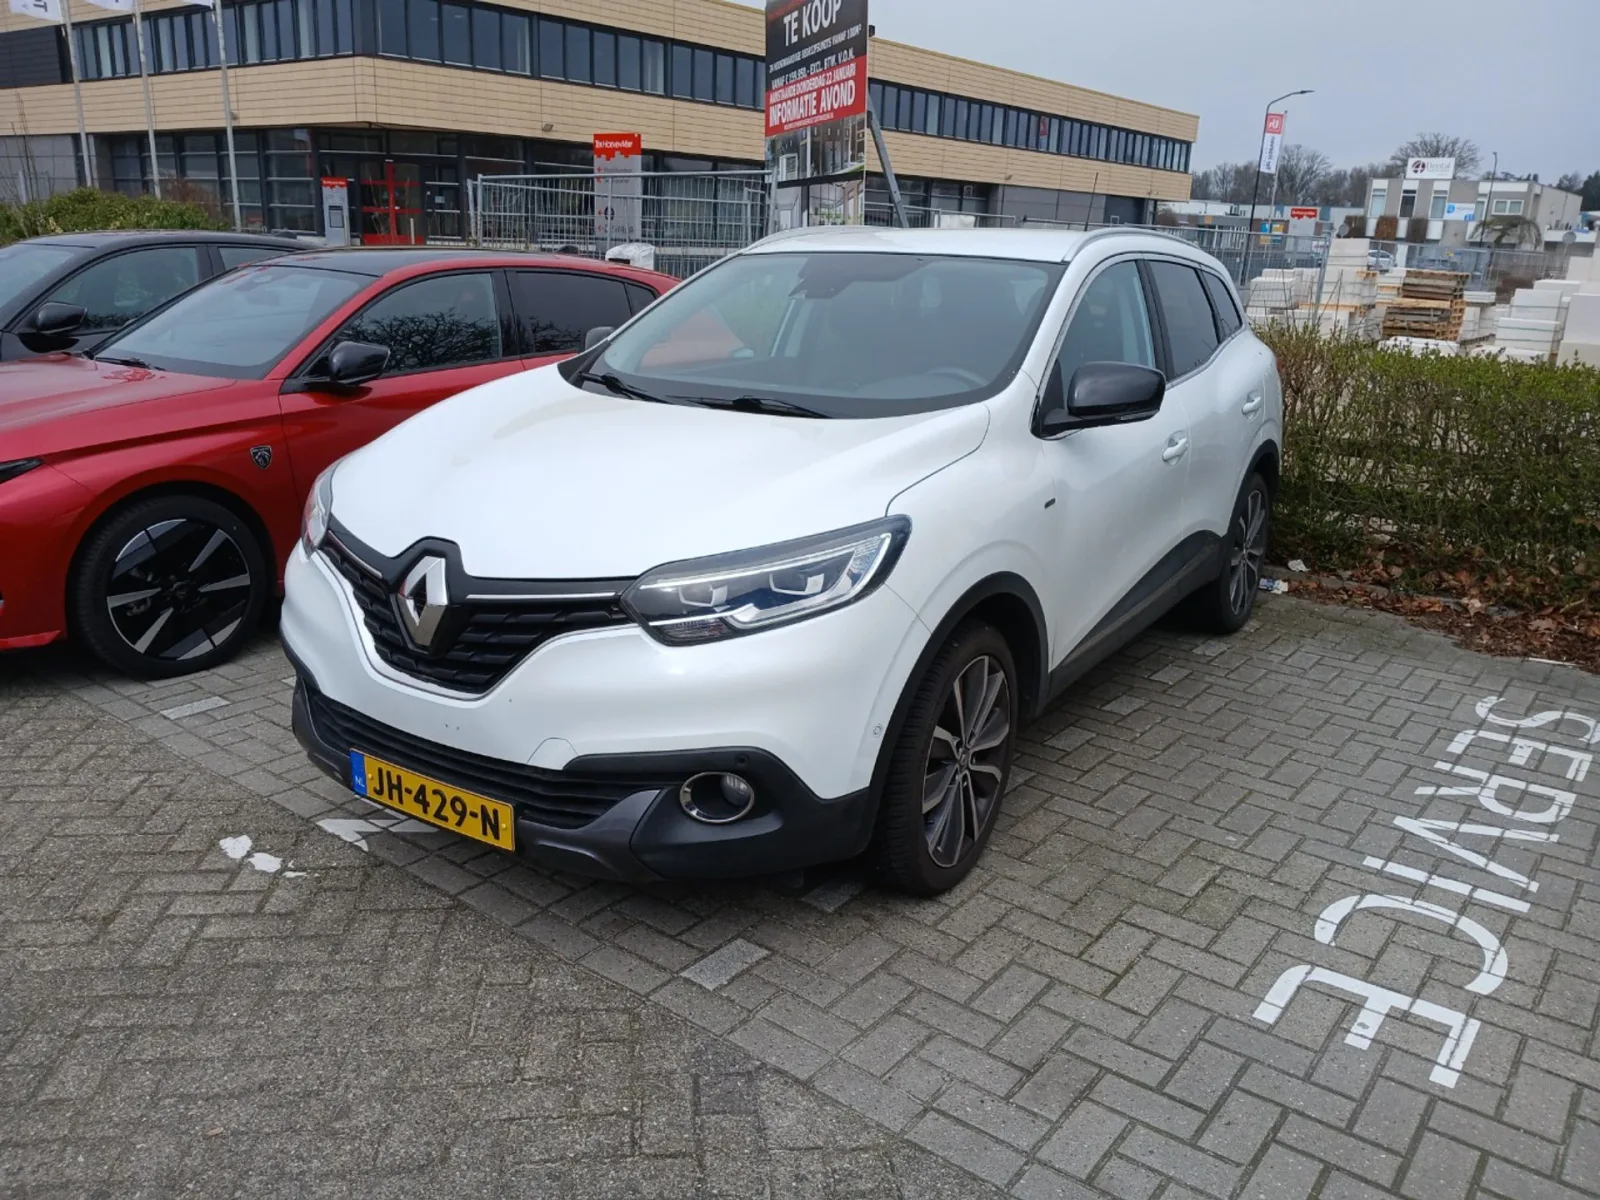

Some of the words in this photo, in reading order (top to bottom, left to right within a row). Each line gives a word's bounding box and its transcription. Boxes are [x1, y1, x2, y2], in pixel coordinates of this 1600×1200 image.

[783, 10, 799, 47] TE
[802, 0, 842, 38] KOOP
[769, 91, 817, 127] INFORMATIE
[820, 79, 856, 113] AVOND
[355, 775, 365, 787] NL
[373, 767, 500, 840] JH-429-N
[1252, 695, 1600, 1088] SERVICE
